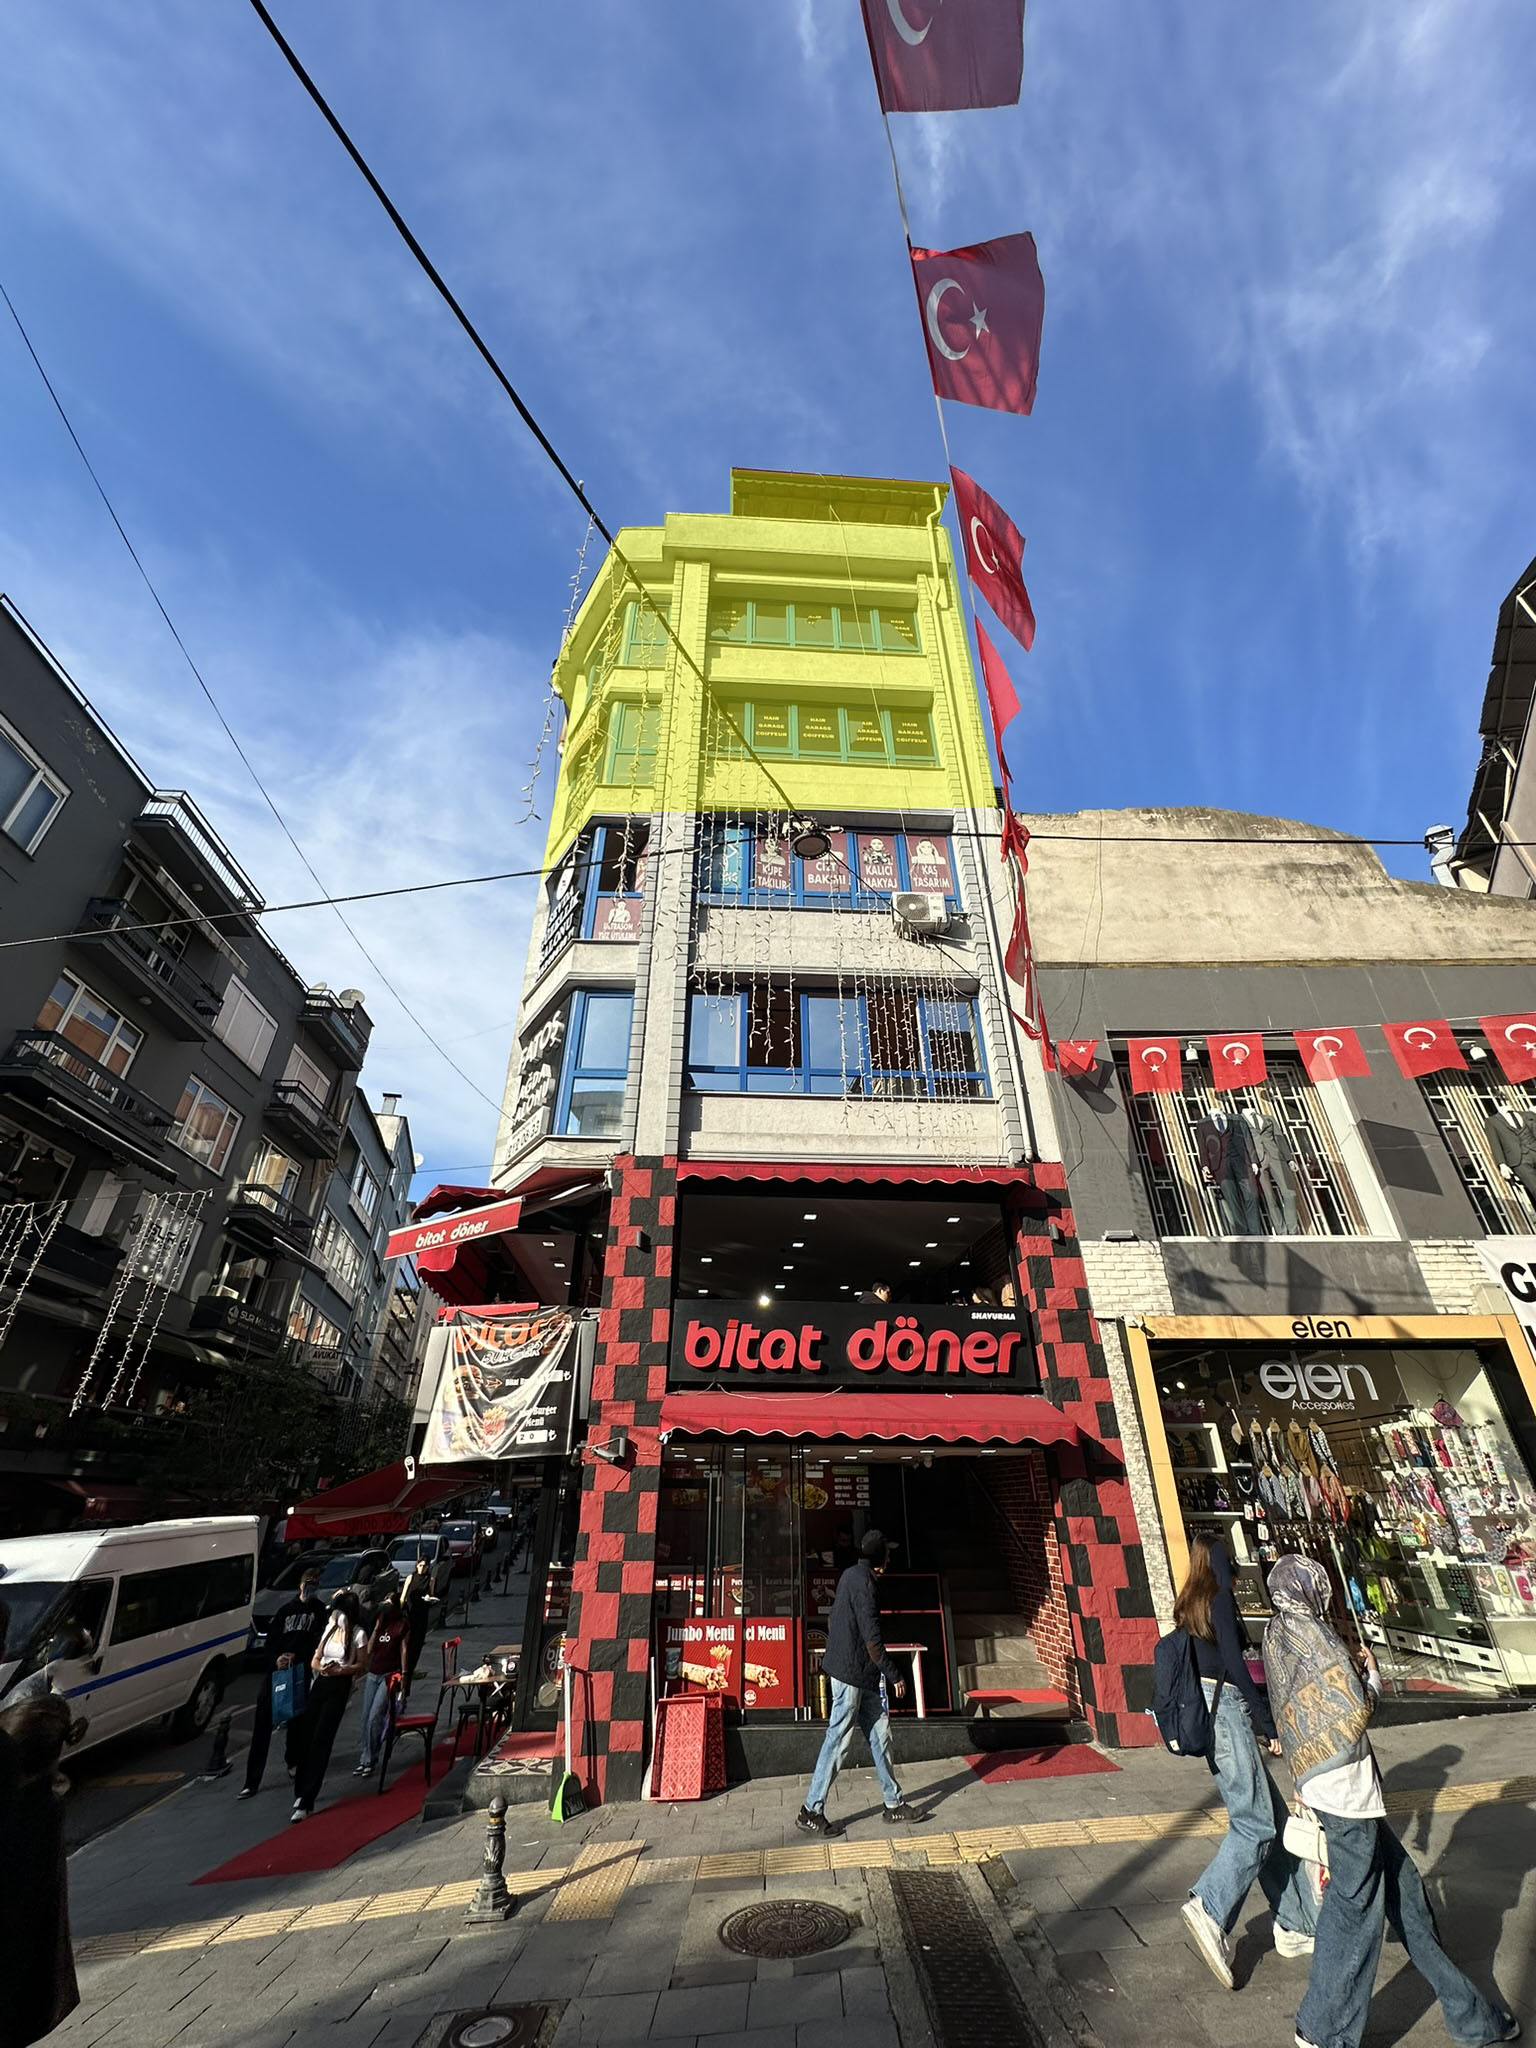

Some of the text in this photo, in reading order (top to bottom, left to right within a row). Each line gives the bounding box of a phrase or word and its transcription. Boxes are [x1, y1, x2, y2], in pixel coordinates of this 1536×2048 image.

[866, 864, 893, 876] KALICI
[921, 864, 938, 877] KAŞ
[864, 877, 898, 889] MAKYAJ
[913, 877, 950, 888] TASARIM
[519, 1010, 562, 1072] FATOŞ
[415, 1220, 489, 1248] bitat döner
[971, 1312, 1016, 1320] SHAVURMA
[1291, 1316, 1352, 1338] elen
[684, 1316, 1022, 1374] bitat döner
[1260, 1350, 1379, 1400] elen
[1291, 1399, 1356, 1411] Accessories
[666, 1625, 735, 1643] Jumbo Menü
[758, 1625, 786, 1641] Menü
